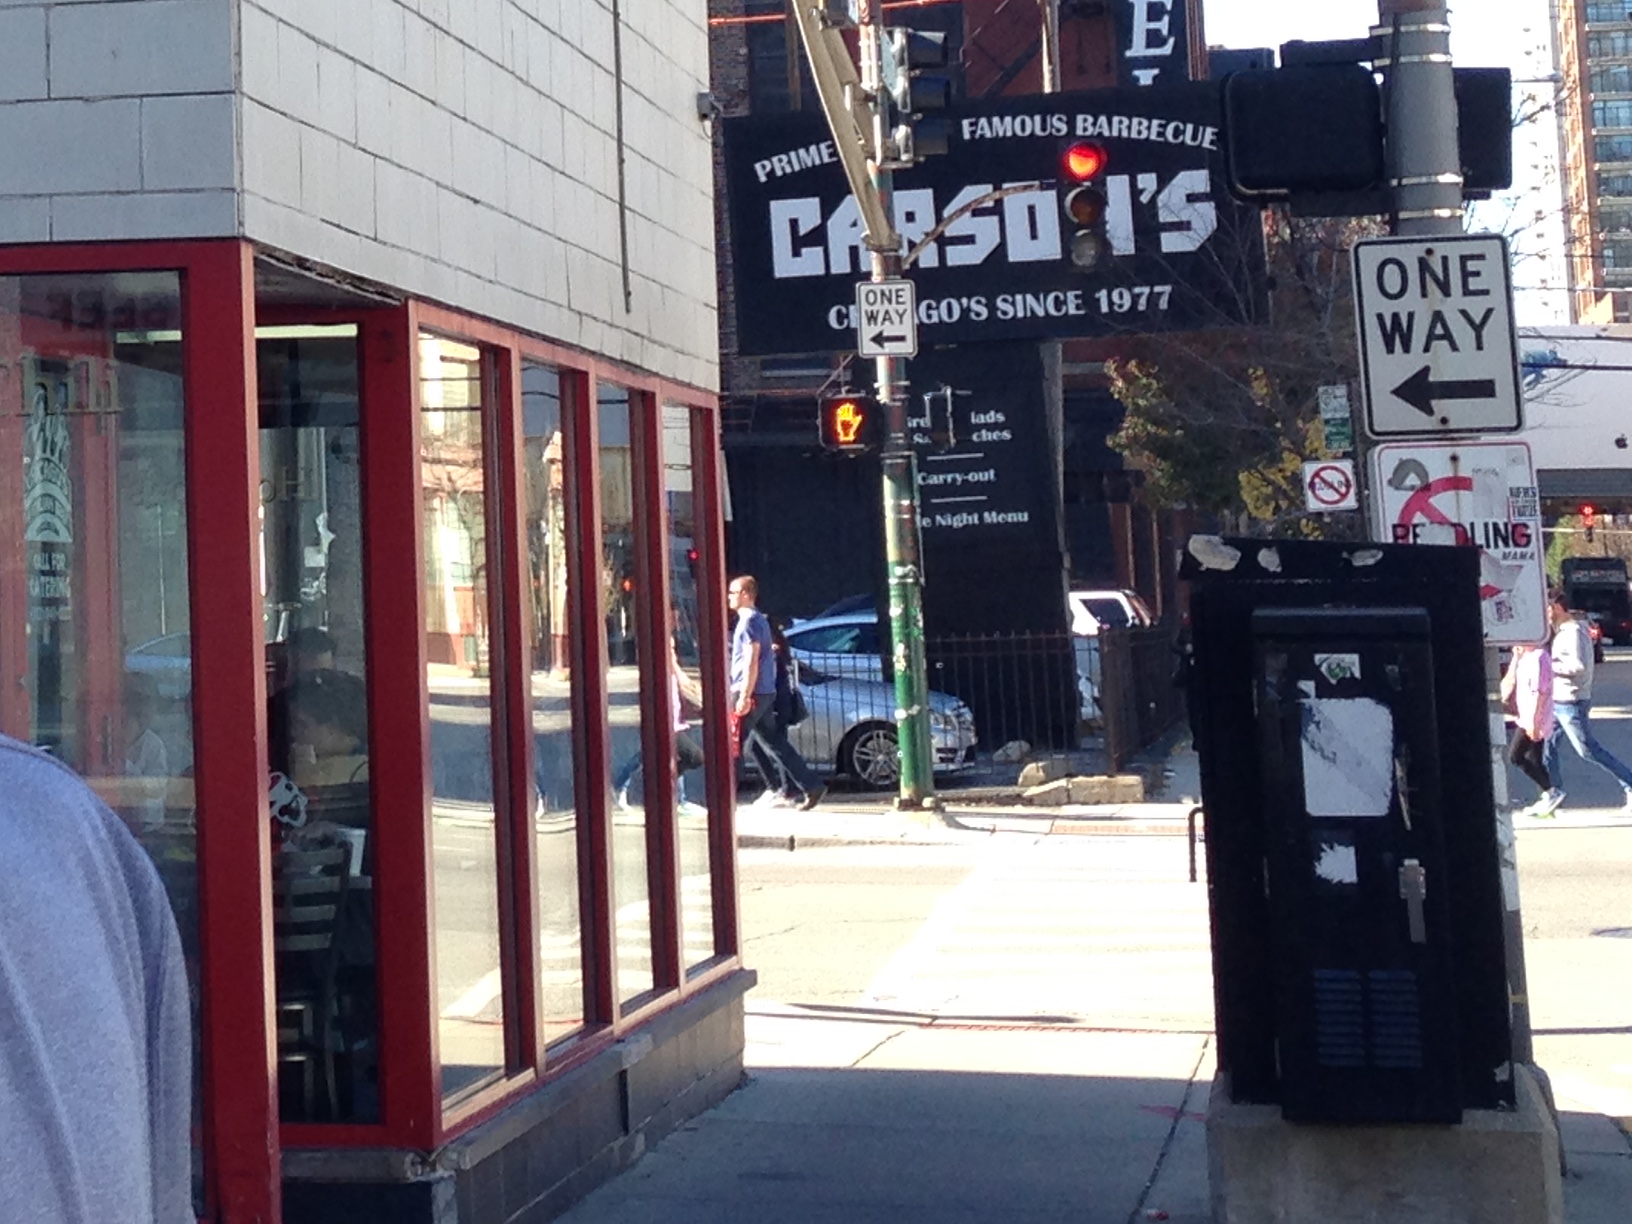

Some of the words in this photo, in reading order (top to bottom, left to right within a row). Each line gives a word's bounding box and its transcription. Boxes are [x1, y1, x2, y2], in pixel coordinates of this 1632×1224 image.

[962, 113, 1068, 141] FAMOUS
[1075, 114, 1220, 151] BARBECUE
[754, 140, 837, 183] PRIME
[1375, 254, 1490, 301] ONE
[864, 289, 906, 307] ONE
[996, 291, 1085, 320] SINCE
[1095, 285, 1173, 314] 1977
[864, 309, 908, 327] WAY
[1375, 308, 1495, 355] WAY
[971, 410, 1006, 424] lads
[916, 469, 996, 486] Carry-out
[936, 513, 980, 528] Night
[984, 511, 1029, 525] Menu
